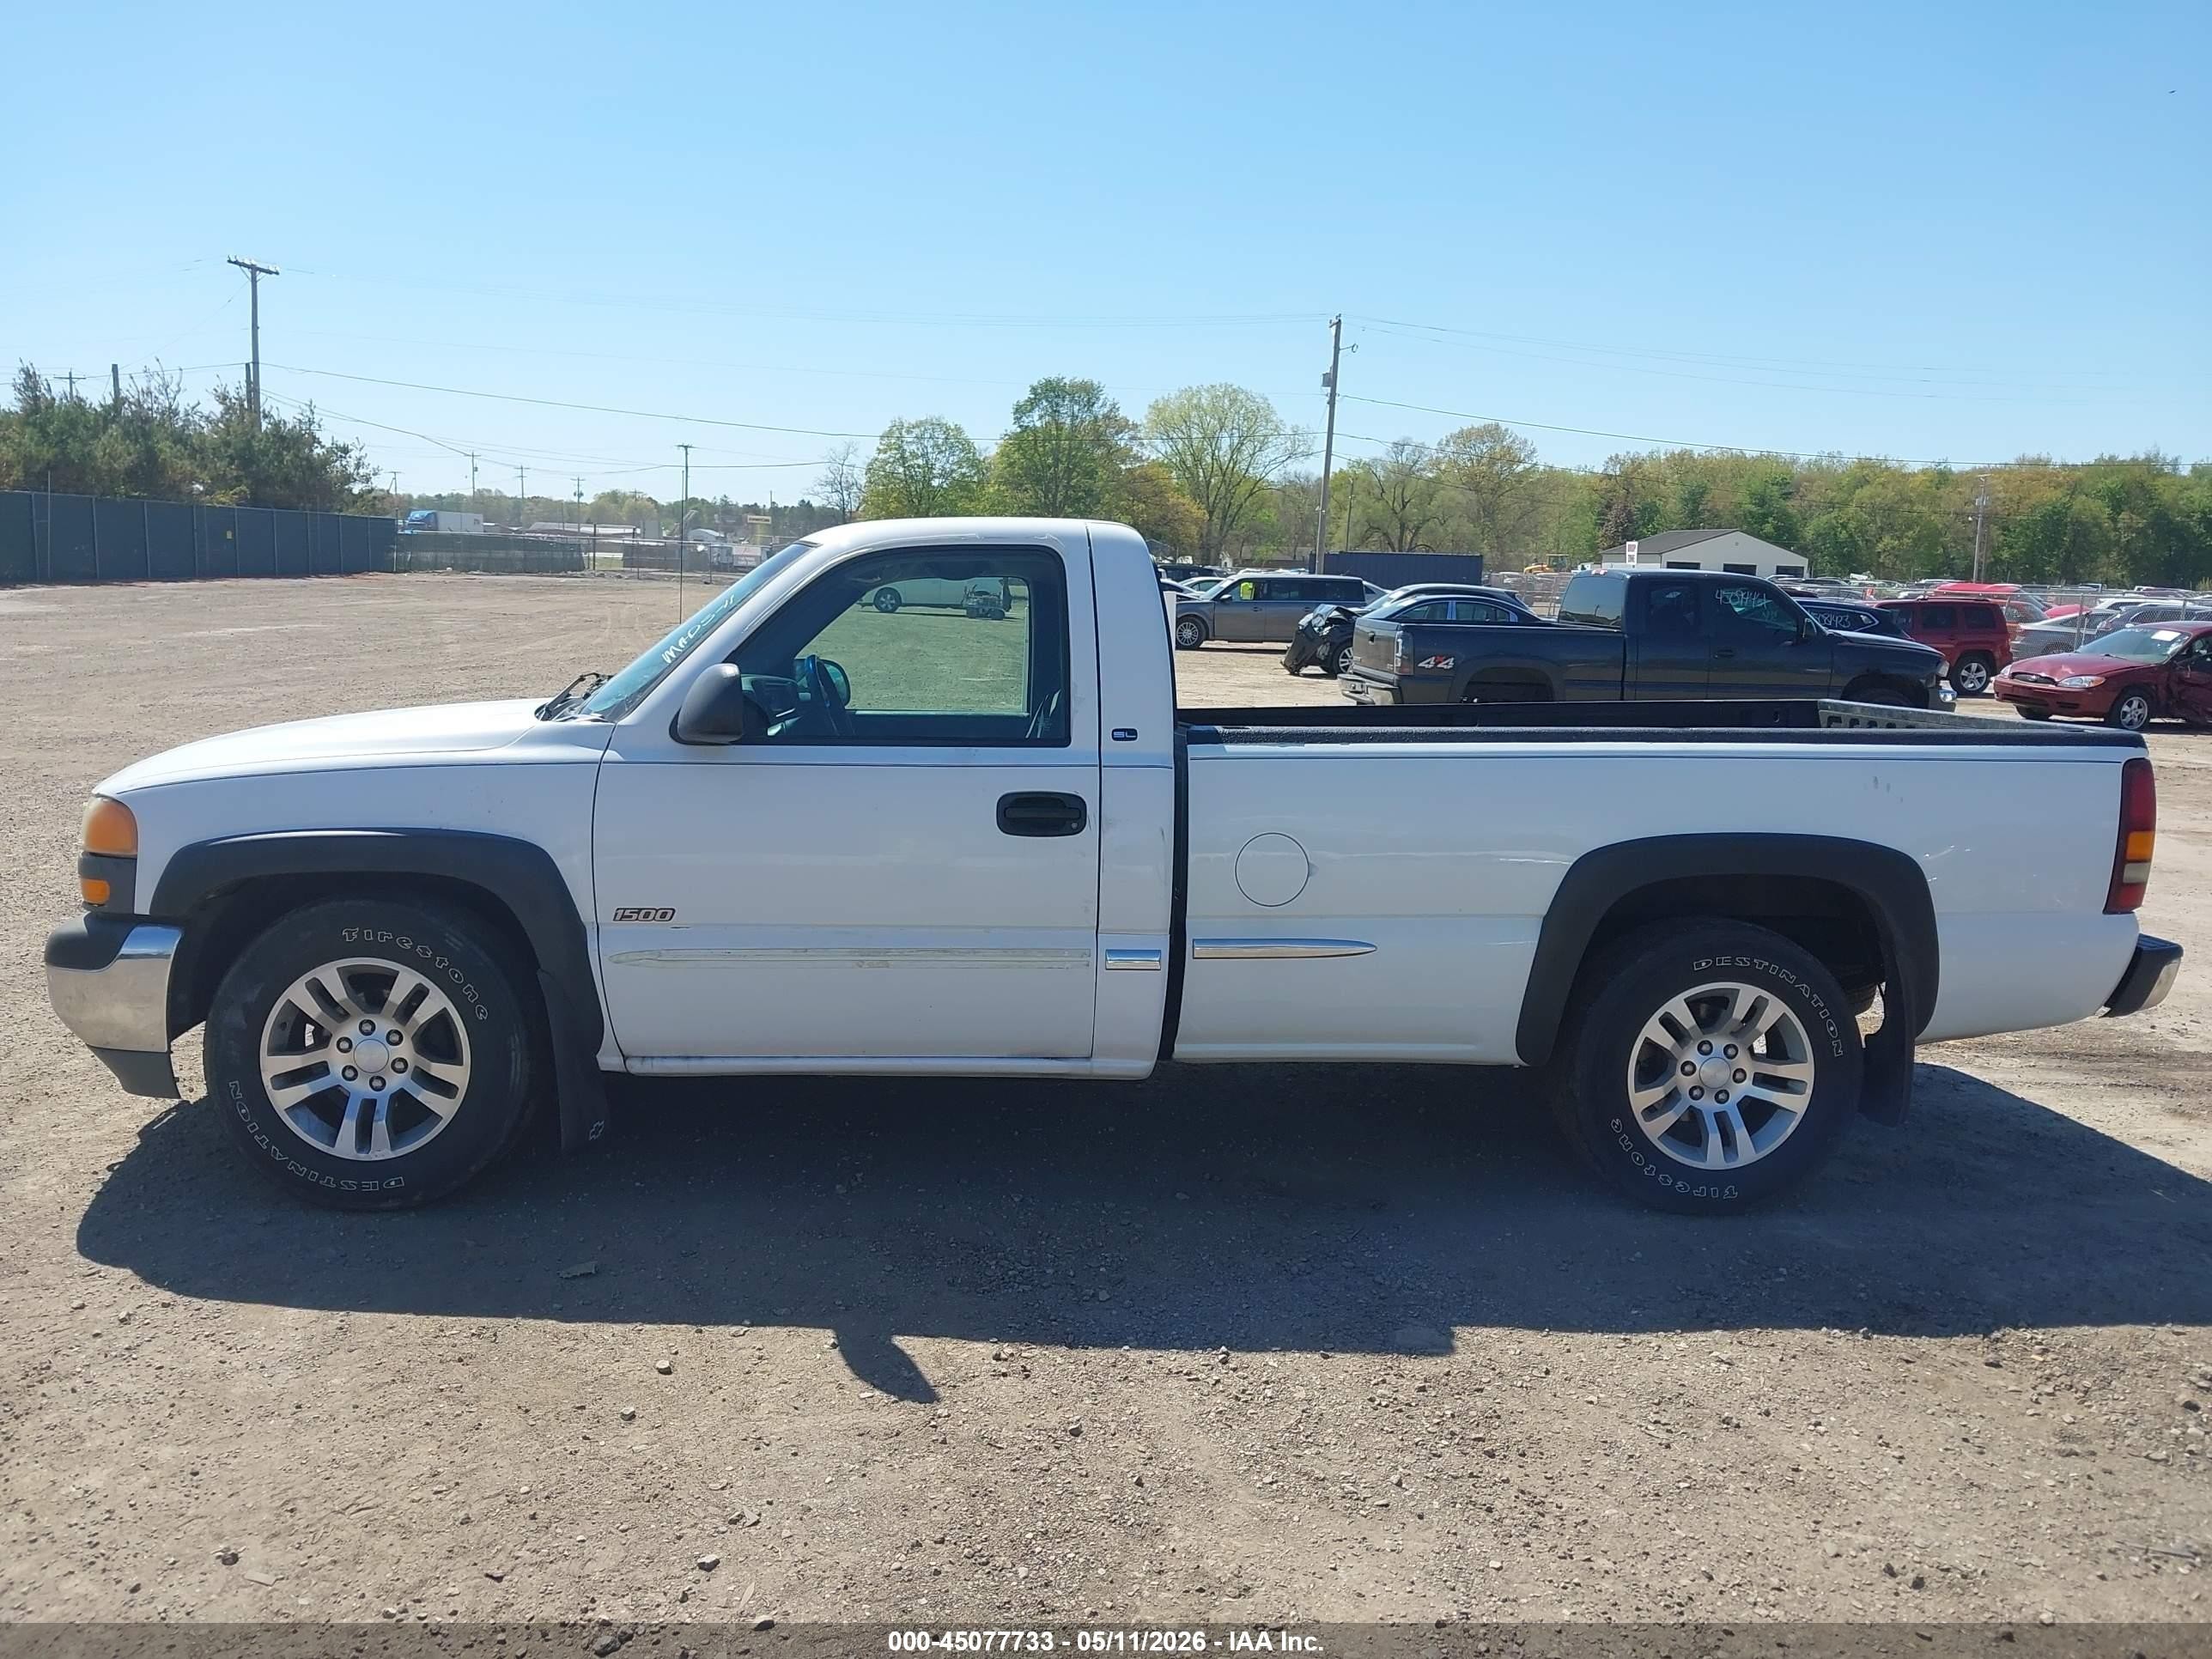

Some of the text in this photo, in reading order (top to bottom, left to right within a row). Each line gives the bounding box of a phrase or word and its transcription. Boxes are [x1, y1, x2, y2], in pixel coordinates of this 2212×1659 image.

[612, 907, 676, 922] 1500
[1692, 956, 1844, 1057] DESTINATION
[228, 1080, 404, 1192] DESTINATION
